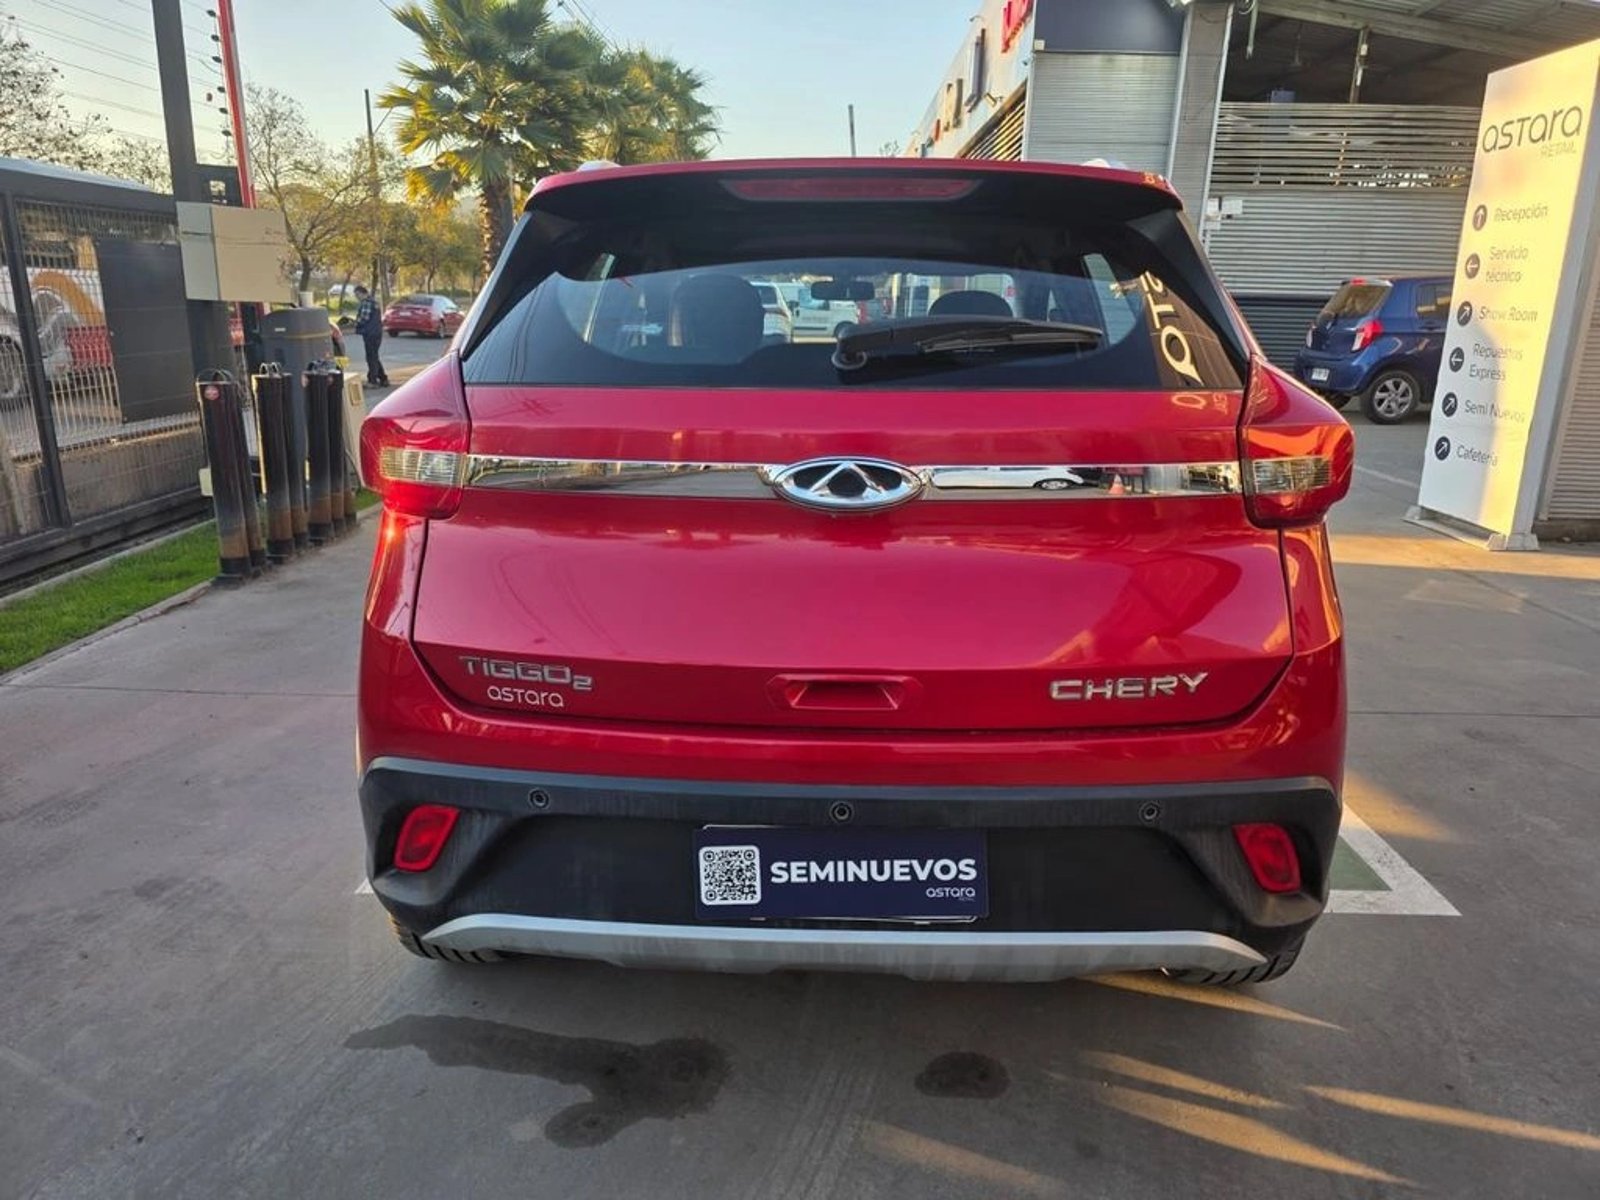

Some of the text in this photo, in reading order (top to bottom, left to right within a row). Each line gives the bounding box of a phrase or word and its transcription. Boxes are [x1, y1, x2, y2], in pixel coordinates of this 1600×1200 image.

[1482, 105, 1583, 153] astara
[1488, 245, 1529, 261] Servicio
[1468, 363, 1507, 382] Express
[1464, 400, 1488, 416] Semi
[487, 685, 564, 707] astara
[1050, 672, 1209, 701] CHERY
[770, 858, 978, 884] SEMINUEVOS
[925, 886, 977, 898] astara
